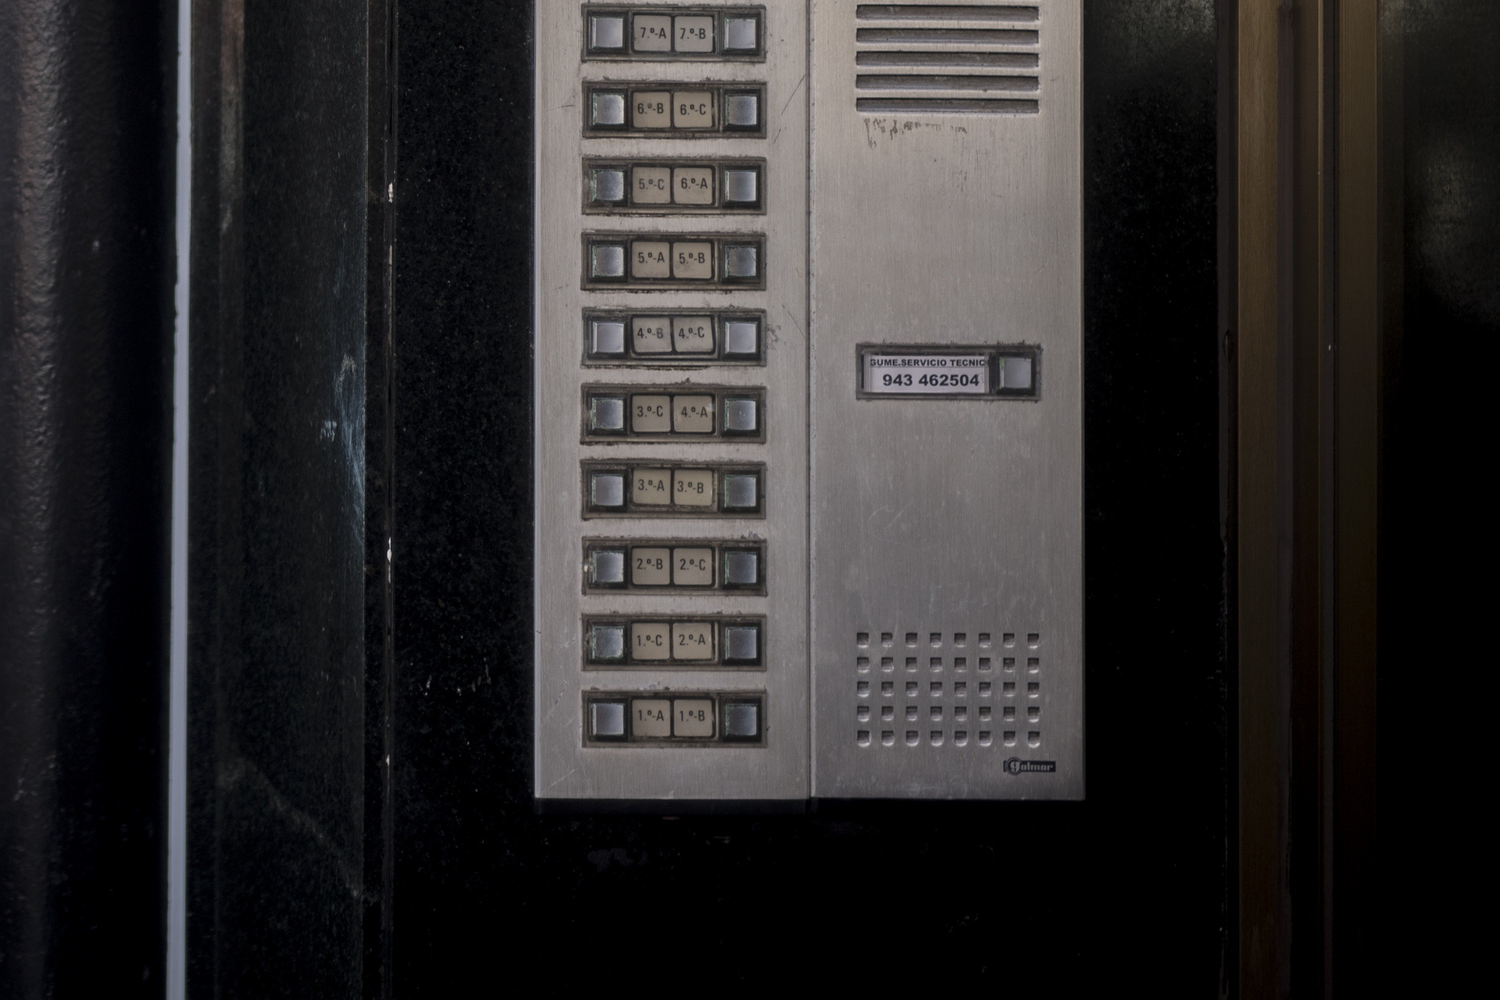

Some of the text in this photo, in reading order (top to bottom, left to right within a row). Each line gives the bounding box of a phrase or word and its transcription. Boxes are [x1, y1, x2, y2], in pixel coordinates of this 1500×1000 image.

[950, 358, 988, 367] TECNIC
[882, 373, 980, 387] 943 462504
